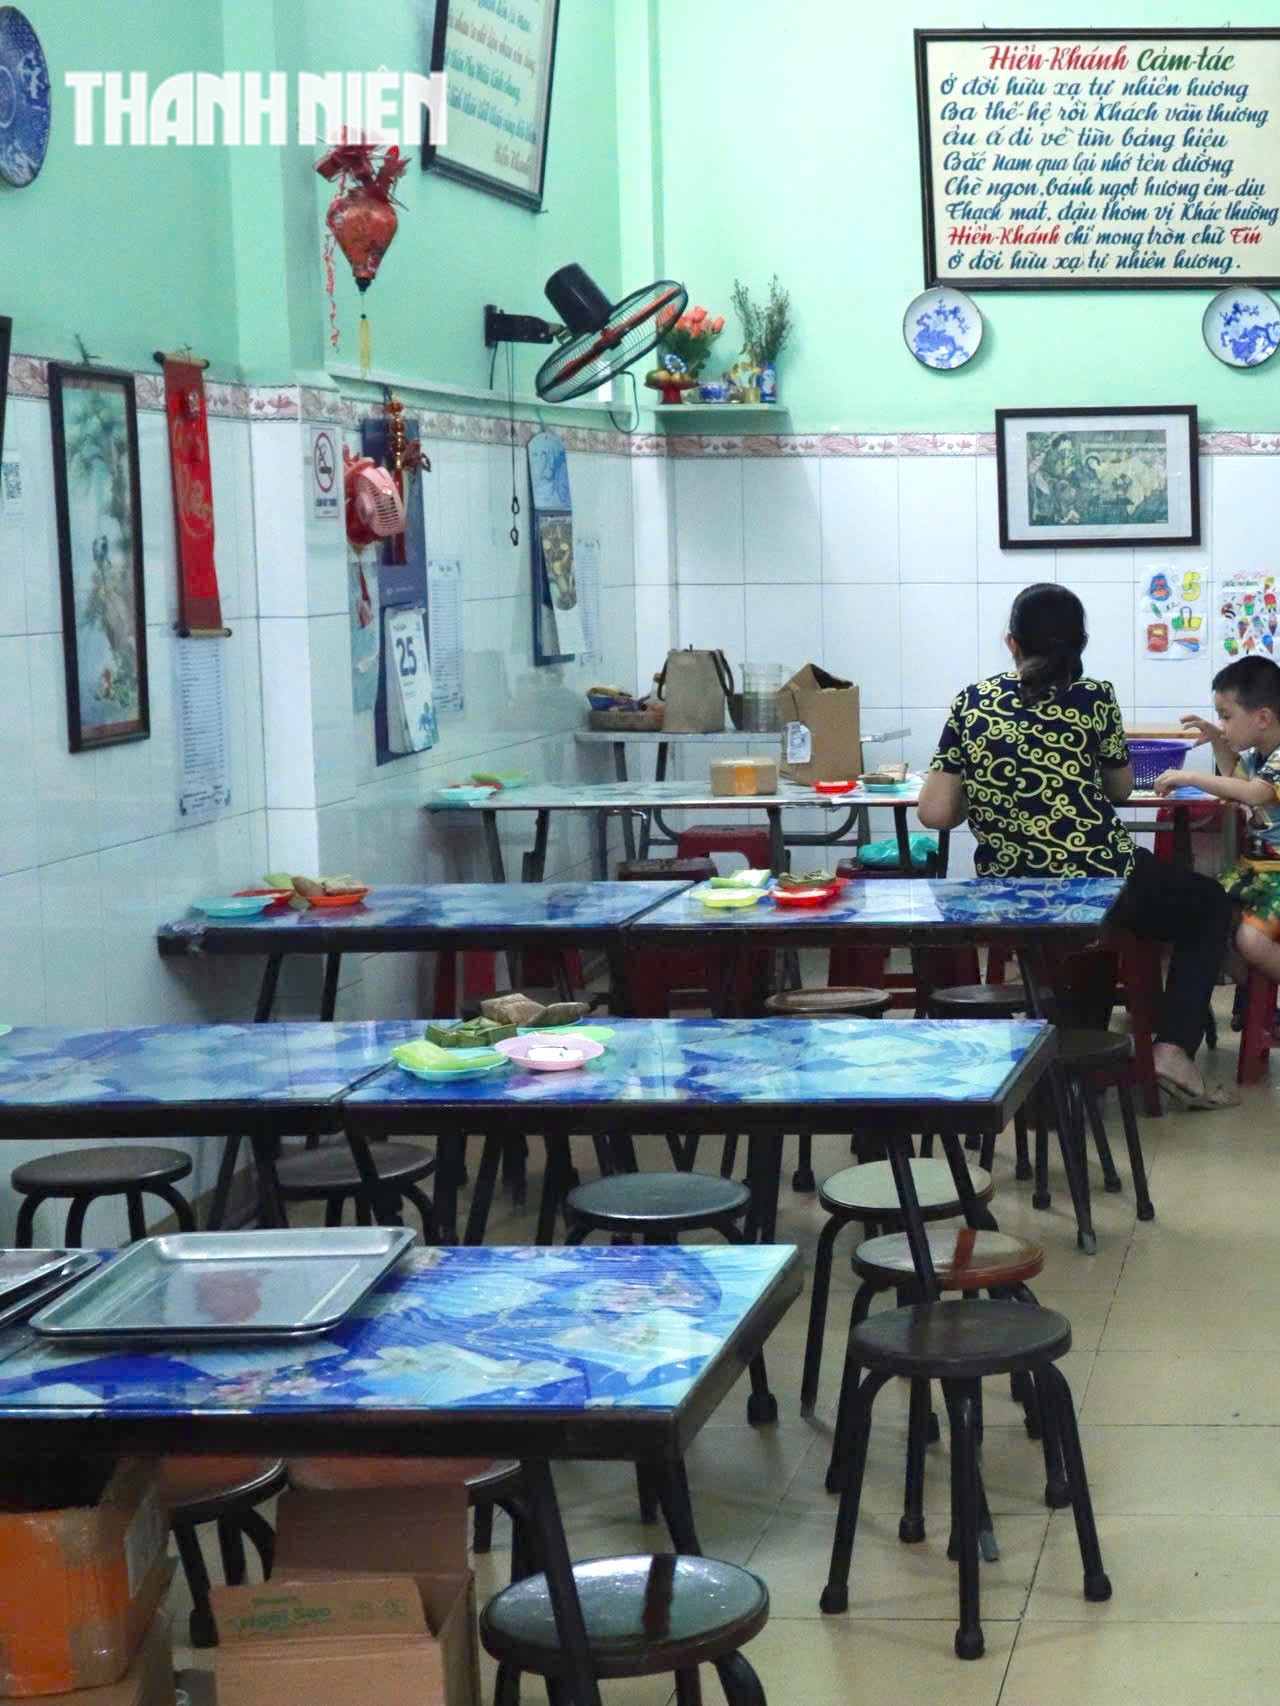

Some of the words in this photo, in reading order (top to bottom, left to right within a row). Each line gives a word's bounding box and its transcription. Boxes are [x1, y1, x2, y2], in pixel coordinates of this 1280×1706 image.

[1137, 46, 1235, 71] Cảm-tác
[962, 75, 999, 95] đời
[1005, 76, 1047, 96] hữu
[1053, 81, 1082, 100] xạ
[1089, 76, 1115, 100] tự
[1122, 75, 1181, 96] nhiên
[1186, 77, 1249, 103] hương
[940, 101, 977, 121] Ba
[1057, 100, 1088, 121] rồi
[1166, 103, 1203, 121] vẫn
[1206, 103, 1269, 128] thương
[1008, 127, 1033, 146] đi
[1041, 126, 1074, 146] về
[1077, 127, 1113, 146] tìm
[1122, 127, 1176, 152] bảng
[1182, 126, 1228, 153] hiệu
[943, 151, 986, 171] Bắc
[992, 153, 1033, 171] Nam
[1035, 157, 1068, 176] qua
[1072, 152, 1097, 176] lại
[1100, 151, 1132, 172] nhớ
[1136, 153, 1168, 172] tên
[1172, 153, 1234, 178] đường
[944, 175, 984, 196] Chè
[1046, 176, 1095, 196] bánh
[1098, 177, 1139, 202] ngọt
[1144, 176, 1200, 202] hương
[945, 200, 1004, 225] Thạch
[1057, 200, 1097, 225] đậu
[1101, 201, 1149, 221] thơm
[1154, 202, 1175, 226] vị
[1224, 200, 1280, 226] thường
[1064, 224, 1095, 245] chỉ
[1096, 231, 1144, 250] mong
[1147, 225, 1186, 245] tròn
[1192, 224, 1226, 245] chữ
[1230, 225, 1262, 245] Tín
[969, 249, 1004, 270] đời
[1010, 250, 1048, 270] hữu
[1052, 256, 1084, 274] xạ
[1088, 250, 1109, 272] tự
[1115, 250, 1167, 270] nhiên
[395, 636, 417, 677] 25
